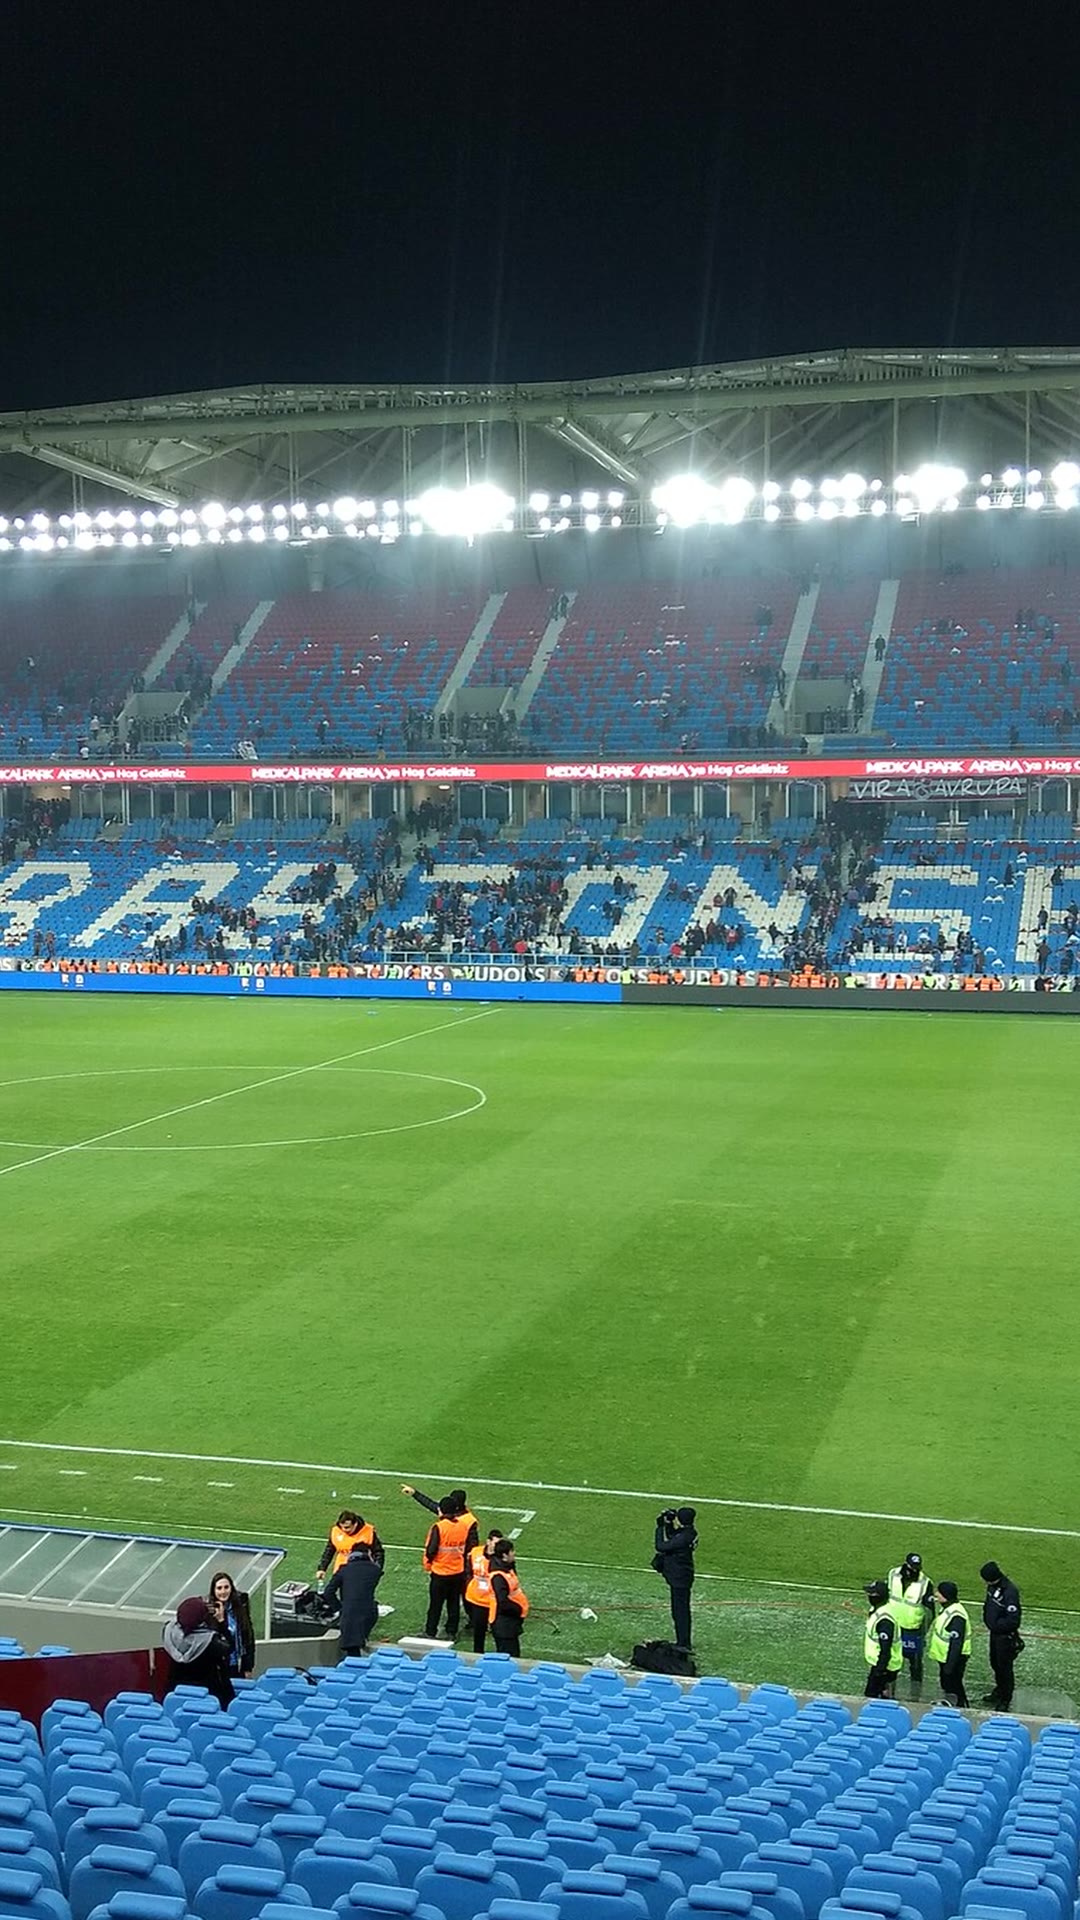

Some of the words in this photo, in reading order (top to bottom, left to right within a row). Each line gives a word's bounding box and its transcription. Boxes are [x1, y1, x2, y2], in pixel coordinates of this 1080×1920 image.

[140, 768, 187, 779] Geldiniz
[252, 767, 335, 780] MEDICALPARK
[426, 766, 476, 778] Geldiniz
[546, 764, 636, 778] MEDICALPARK
[734, 762, 790, 775] Geldiniz
[866, 760, 965, 774] MEDICALPARK
[854, 778, 911, 799] VIRA
[935, 776, 1022, 798] AVRUPA
[462, 965, 546, 982] UDOS
